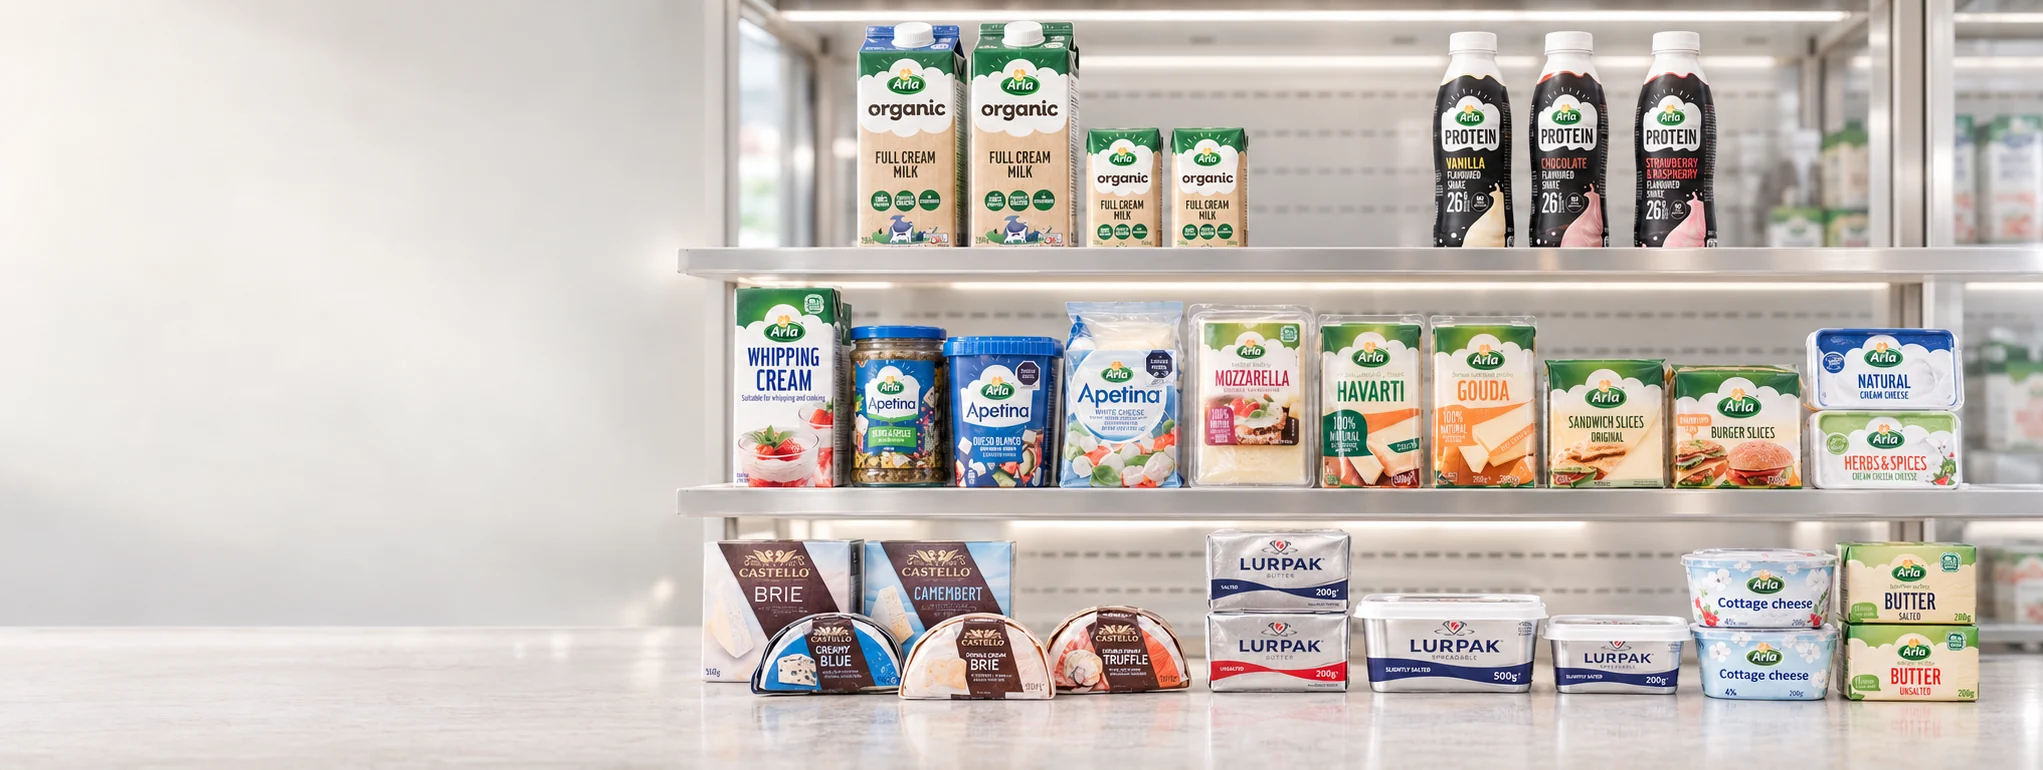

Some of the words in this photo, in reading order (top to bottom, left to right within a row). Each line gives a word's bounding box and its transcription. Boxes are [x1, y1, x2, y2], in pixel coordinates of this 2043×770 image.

[892, 78, 920, 90] Arla
[1006, 79, 1034, 90] Arla
[868, 99, 946, 120] organic
[981, 100, 1058, 121] organic
[1556, 110, 1577, 121] Arla
[1460, 111, 1480, 122] Arla
[1660, 111, 1681, 122] Arla
[1445, 129, 1496, 144] PROTEIN
[1541, 128, 1593, 144] PROTEIN
[1646, 129, 1697, 145] PROTEIN
[875, 151, 899, 164] FULL
[902, 151, 936, 164] CREAM
[989, 151, 1014, 164] FULL
[1016, 151, 1050, 164] CREAM
[1446, 157, 1485, 169] VANILLA
[1541, 158, 1587, 169] CHOCOLATE
[1646, 158, 1698, 168] STRAWBERRY
[894, 165, 918, 178] MILK
[1008, 165, 1032, 178] MILK
[1097, 172, 1148, 186] organic
[1182, 172, 1233, 186] organic
[1100, 200, 1117, 209] FULL
[1119, 200, 1144, 209] CREAM
[1186, 200, 1202, 209] FULL
[1204, 200, 1229, 209] CREAM
[1446, 192, 1463, 212] 26
[1541, 192, 1558, 213] 26
[1646, 201, 1662, 220] 26
[770, 325, 798, 337] Arla
[747, 347, 820, 366] WHIPPING
[1357, 352, 1384, 363] Arla
[1472, 354, 1499, 365] Arla
[1870, 352, 1897, 363] Arla
[1105, 368, 1128, 379] Arla
[1215, 370, 1290, 387] MOZZARELLA
[756, 369, 812, 391] CREAM
[1858, 374, 1911, 388] NATURAL
[880, 382, 900, 392] Arla
[986, 384, 1009, 396] Arla
[1337, 380, 1404, 402] HAVARTI
[1457, 380, 1510, 401] GOUDA
[772, 394, 795, 403] whipping
[1077, 382, 1160, 408] Apetina
[1591, 390, 1620, 403] Arla
[1860, 391, 1882, 399] CREAM
[1884, 391, 1909, 399] CHEESE
[868, 397, 916, 413] Apetina
[1724, 399, 1754, 412] Arla
[966, 402, 1029, 422] Apetina
[1443, 411, 1463, 423] 100%
[1334, 416, 1356, 430] 100%
[1568, 416, 1614, 428] SANDWICH
[1616, 416, 1644, 428] SLICES
[1591, 432, 1624, 442] ORIGINAL
[1711, 426, 1744, 438] BURGER
[1747, 426, 1775, 438] SLICES
[1872, 434, 1898, 445] Arla
[1240, 558, 1322, 570] LURPAK
[739, 568, 809, 578] CASTELLO
[902, 567, 970, 577] CASTELLO
[1897, 567, 1921, 578] Arla
[1752, 579, 1779, 590] Arla
[755, 586, 803, 602] BRIE
[914, 587, 982, 601] CAMEMBERT
[1316, 589, 1336, 598] 200g
[1718, 597, 1768, 611] Cottage
[1771, 598, 1813, 609] cheese
[1885, 592, 1936, 610] BUTTER
[816, 645, 850, 655] CREAMY
[1239, 640, 1321, 652] LURPAK
[1410, 639, 1500, 653] LURPAK
[1902, 646, 1926, 657] Arla
[820, 655, 852, 667] BLUE
[1103, 654, 1148, 665] TRUFFLE
[1584, 653, 1651, 664] LURPAK
[1751, 651, 1778, 662] Arla
[970, 659, 1000, 671] BRIE
[1316, 670, 1336, 679] 200g
[1493, 672, 1517, 682] 500g
[1646, 676, 1666, 685] 200g
[1719, 668, 1765, 682] Cottage
[1769, 670, 1809, 681] cheese
[1891, 667, 1941, 685] BUTTER
[1725, 688, 1737, 696] 4%
[1900, 687, 1932, 696] UNSALTED
[1958, 689, 1975, 698] 200g
